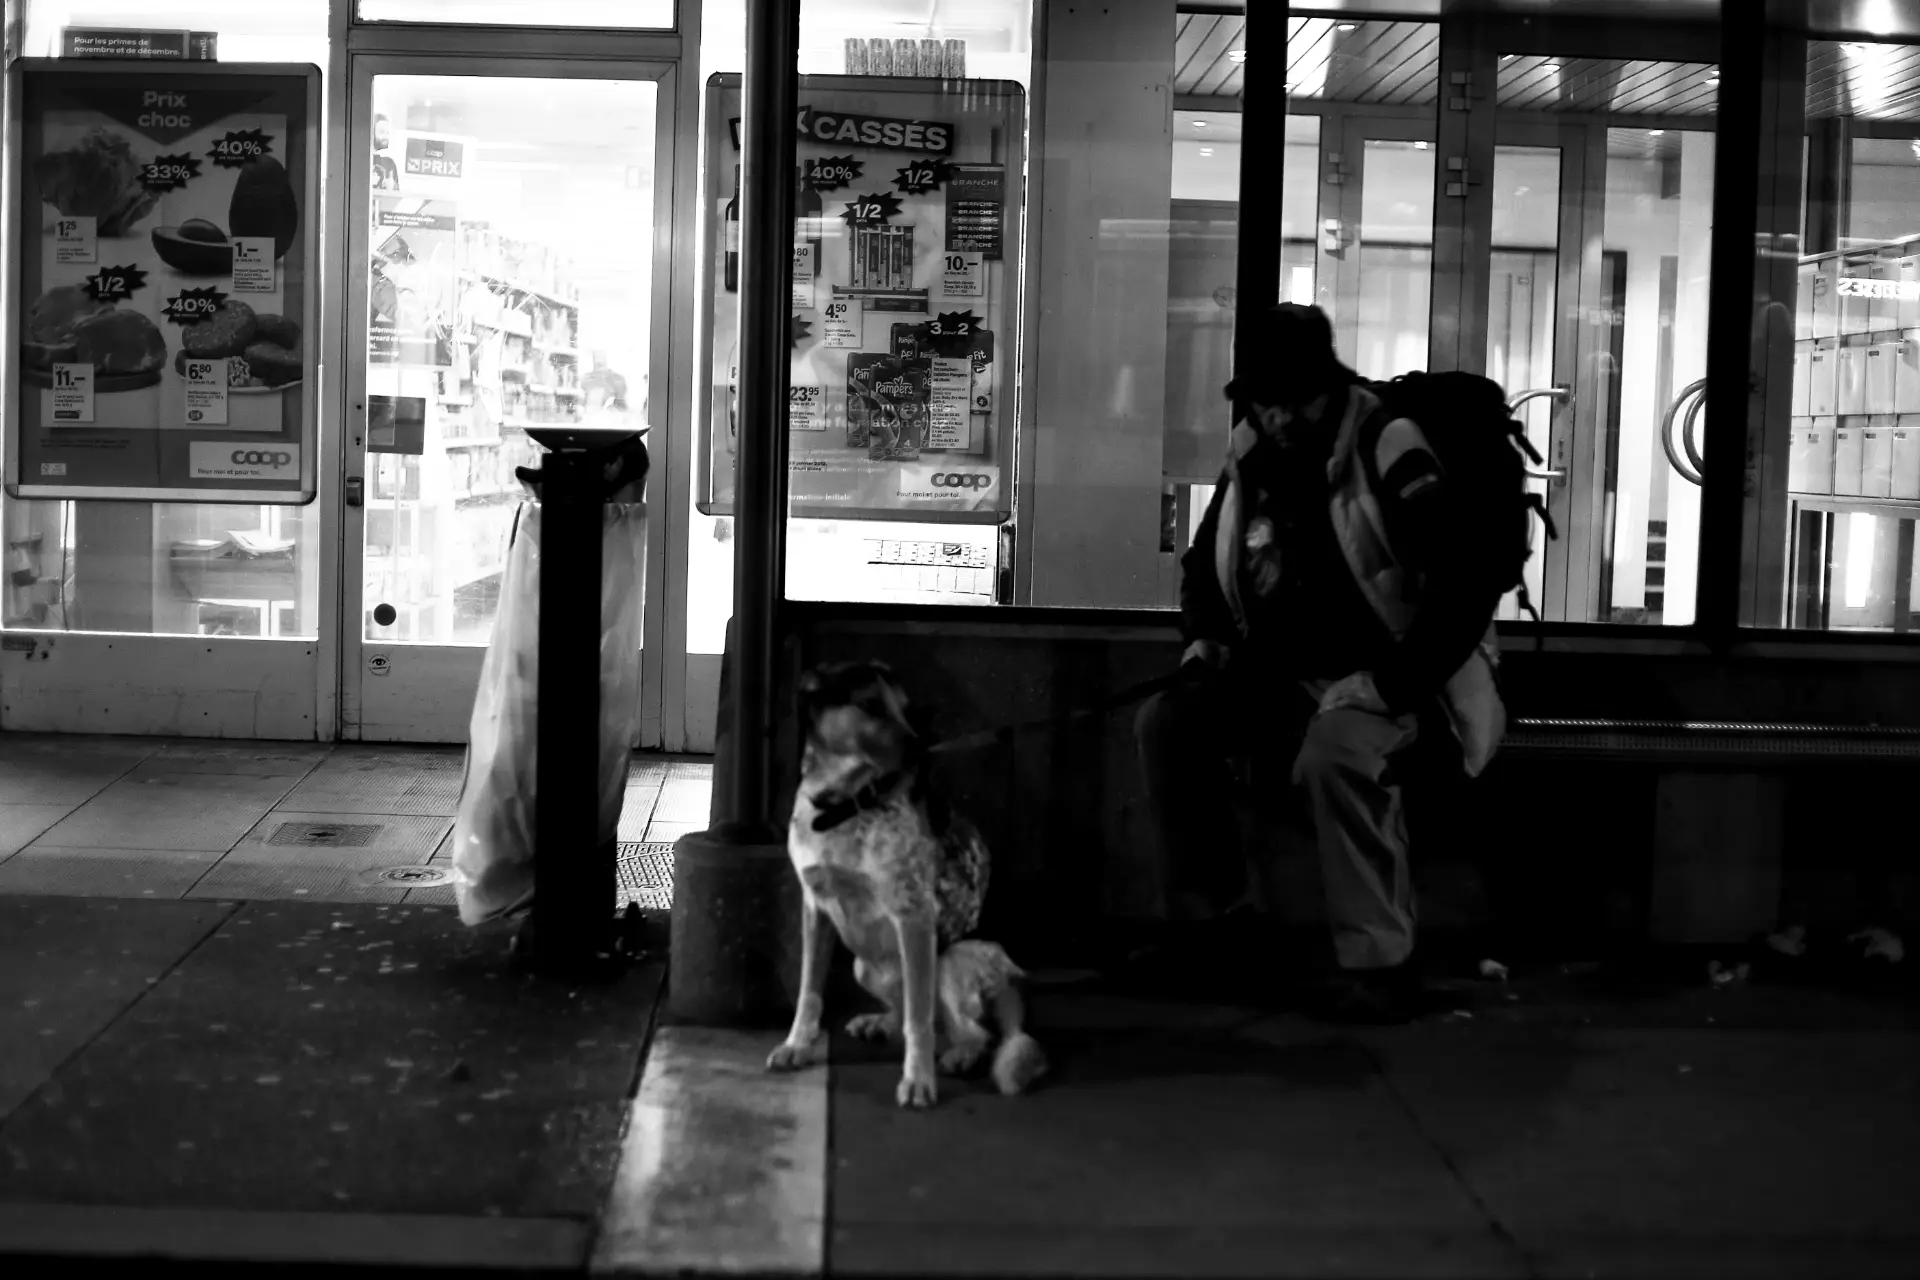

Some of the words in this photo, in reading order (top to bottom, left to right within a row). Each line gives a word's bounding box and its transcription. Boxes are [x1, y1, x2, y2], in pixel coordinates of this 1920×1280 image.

[108, 38, 137, 46] primes
[138, 38, 149, 46] de
[137, 47, 180, 55] décembre.
[142, 90, 188, 108] Prix
[138, 111, 192, 128] choc
[813, 115, 947, 151] CASSÉS
[217, 140, 262, 155] 40%
[147, 164, 190, 179] 33%
[421, 160, 461, 175] PRIX
[810, 166, 853, 180] 40%
[904, 169, 934, 185] 1/2
[852, 204, 882, 219] 1/2
[94, 276, 125, 292] 1/2
[171, 298, 217, 313] 40%
[825, 303, 847, 319] 4.50
[930, 321, 942, 335] 3
[957, 322, 969, 335] 2
[188, 363, 212, 380] 6.80
[790, 386, 820, 402] 23.95
[231, 450, 292, 470] coop
[234, 469, 250, 477] pour
[930, 472, 992, 492] coop
[933, 492, 949, 500] pour
